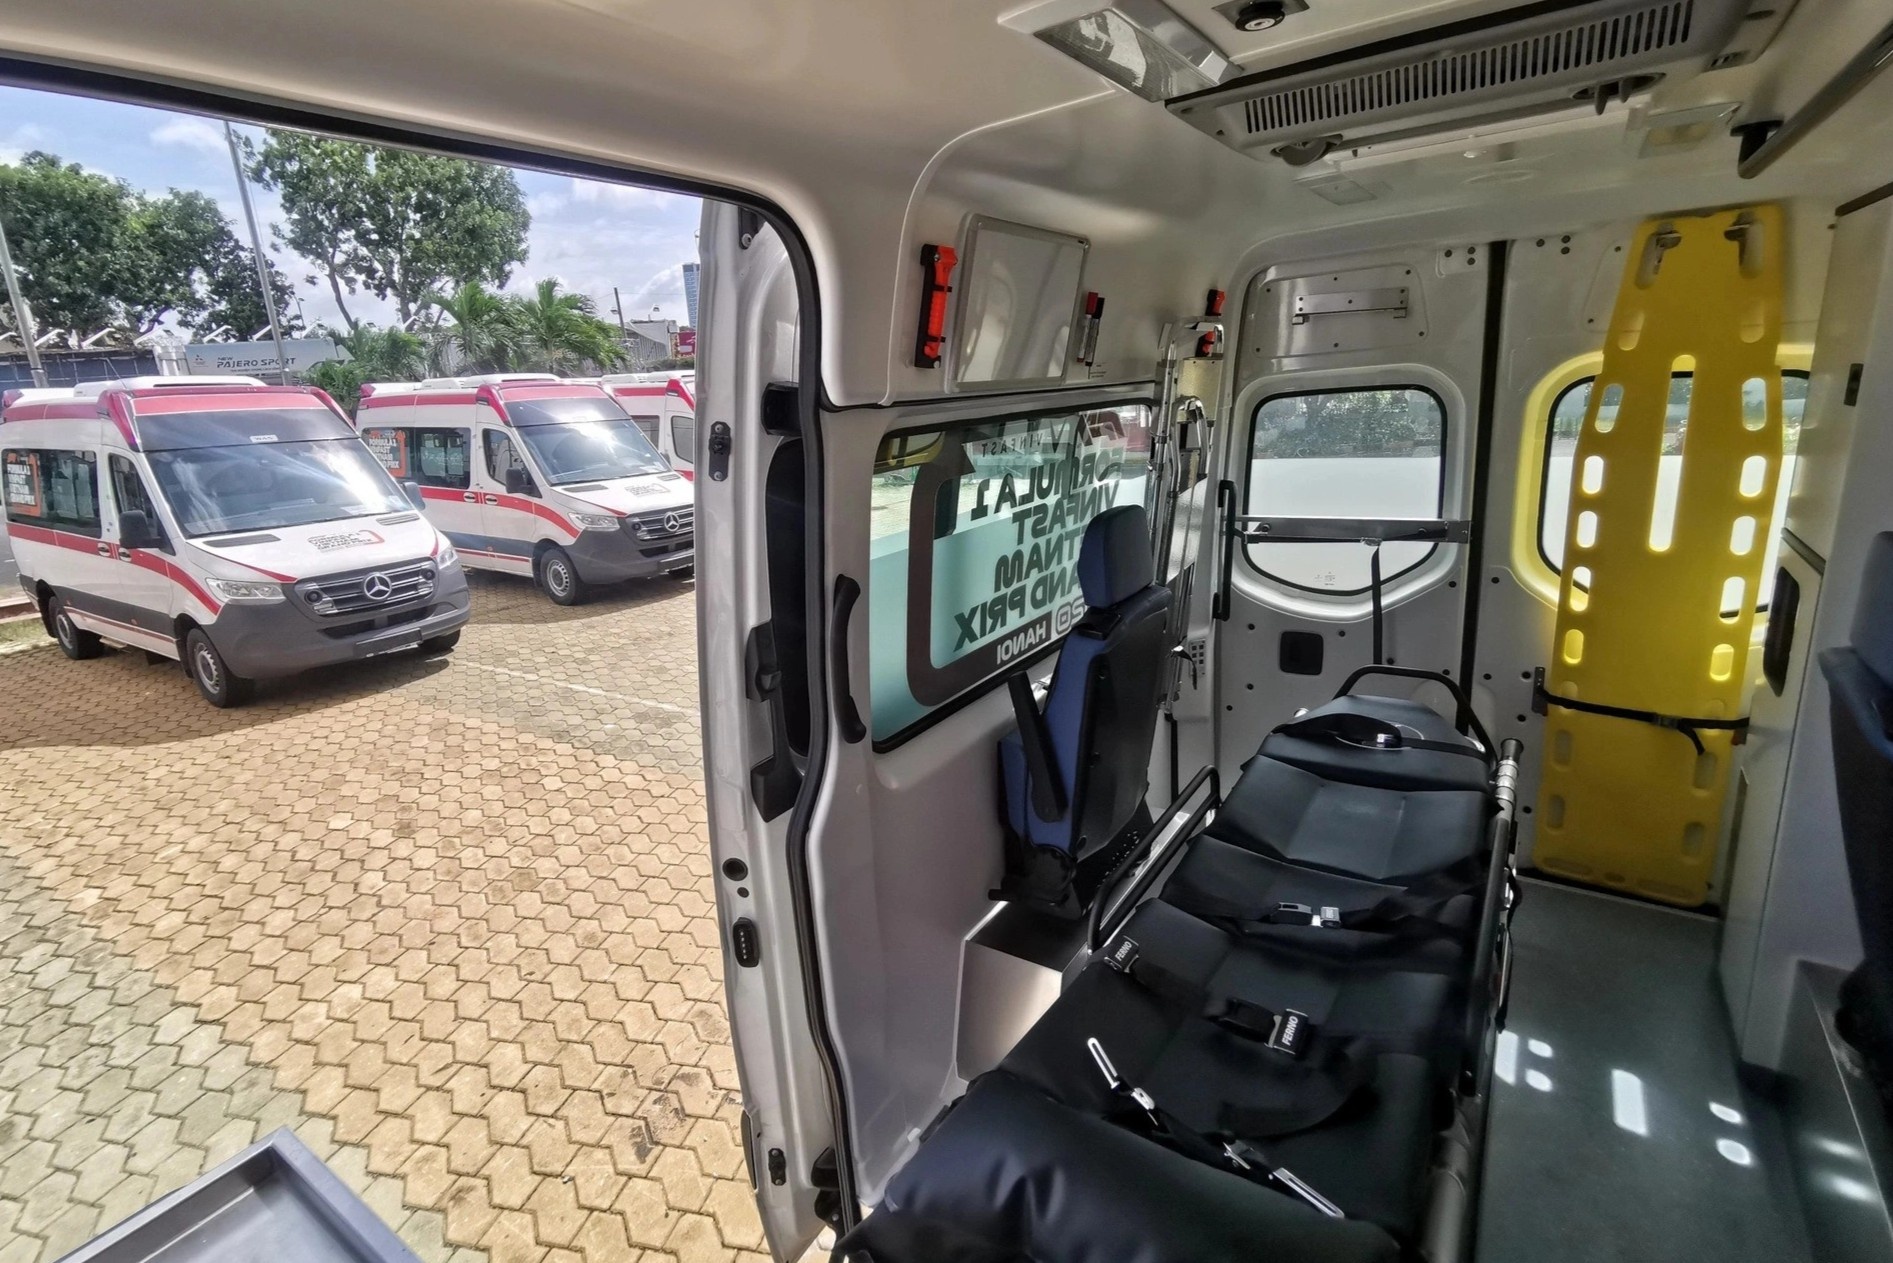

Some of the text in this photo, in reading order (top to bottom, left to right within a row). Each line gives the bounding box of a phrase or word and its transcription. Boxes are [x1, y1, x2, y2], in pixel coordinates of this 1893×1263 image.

[216, 359, 258, 369] PAJERO
[1115, 941, 1132, 961] FERNO
[1281, 1015, 1299, 1047] FERNO
